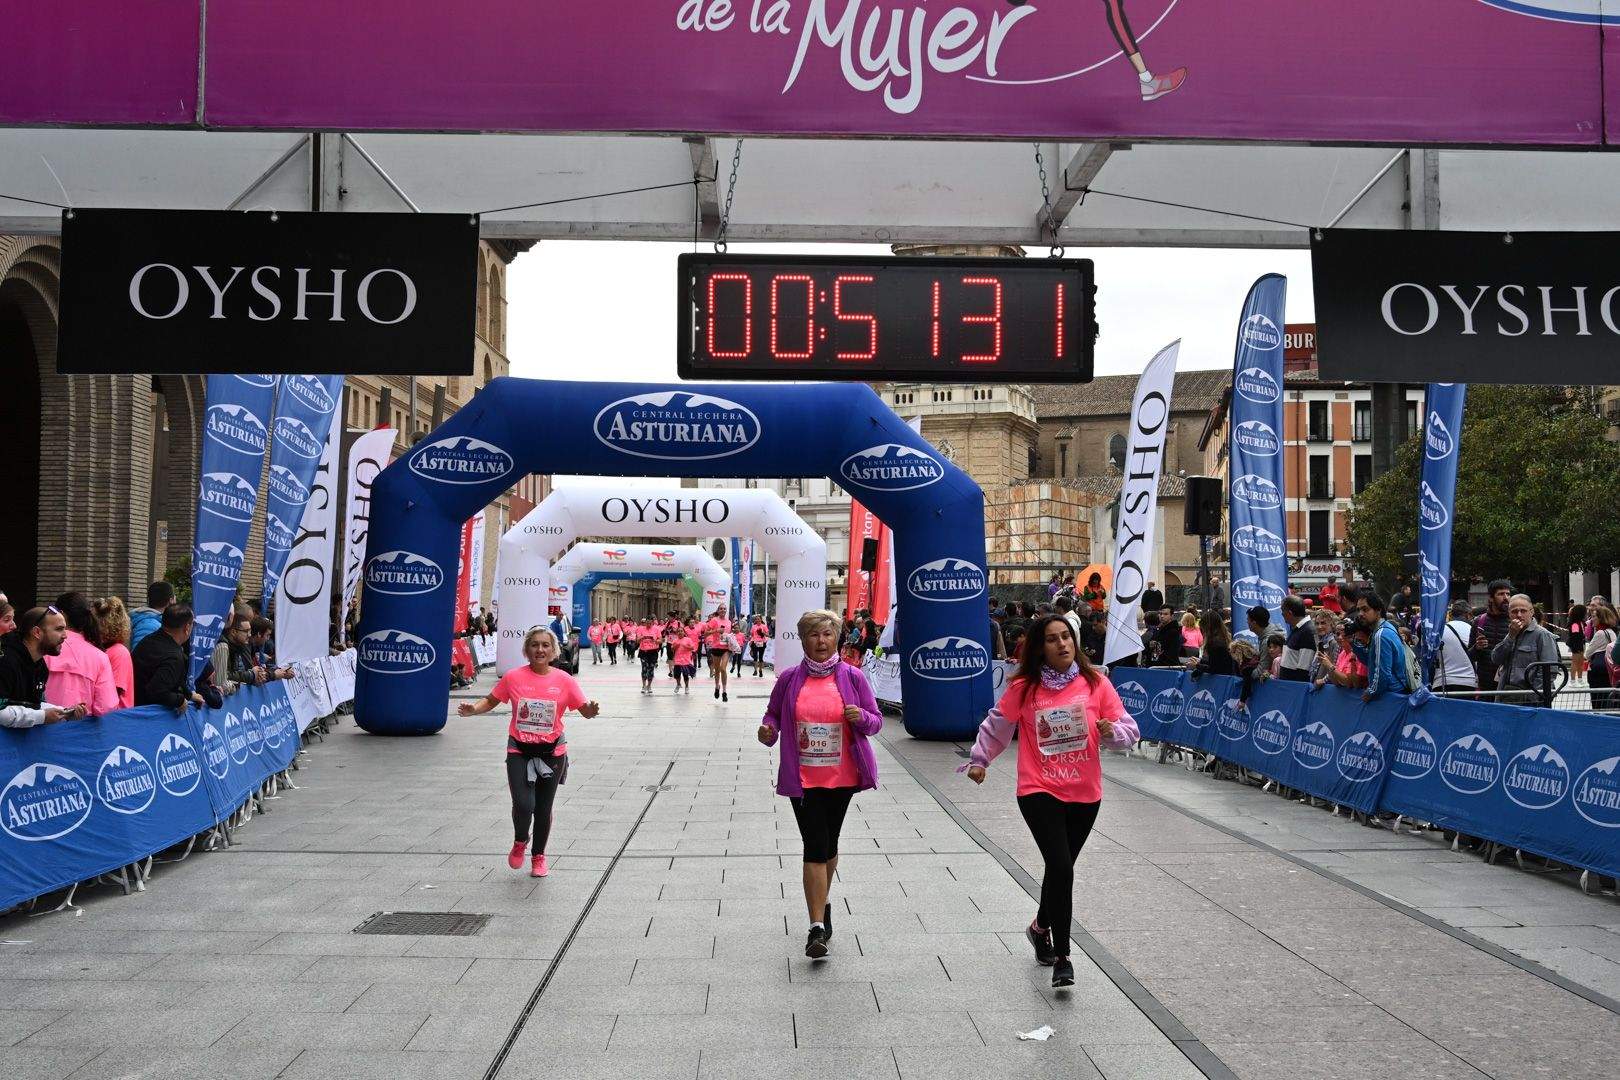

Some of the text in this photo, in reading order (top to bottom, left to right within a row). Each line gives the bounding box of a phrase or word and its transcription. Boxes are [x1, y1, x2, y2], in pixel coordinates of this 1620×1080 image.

[677, 0, 1038, 114] de la Mujer
[129, 263, 417, 325] OYSHO
[289, 376, 328, 410] ASTURIANA
[606, 411, 748, 443] ASTURIANA
[632, 410, 743, 420] CENTRAL LECHERA
[207, 412, 265, 450] ASTURIANA
[275, 422, 316, 455] ASTURIANA
[414, 452, 505, 473] ASTURIANA
[849, 462, 938, 479] ASTURIANA
[601, 498, 730, 524] OYSHO
[1115, 391, 1167, 605] OYSHO
[524, 525, 563, 535] OYSHO
[765, 526, 803, 536] OYSHO
[366, 565, 437, 585] ASTURIANA
[504, 577, 541, 587] OYSHO
[784, 579, 820, 589] OYSHO
[913, 575, 982, 592] ASTURIANA
[360, 644, 429, 663] ASTURIANA
[914, 653, 985, 670] ASTURIANA
[160, 758, 199, 785] ASTURIANA
[1395, 748, 1431, 769] TURIANA
[1442, 751, 1494, 783] ASTURIANA
[105, 773, 153, 802] ASTURIANA
[1506, 763, 1562, 797] ASTURIANA
[8, 791, 88, 829] ASTURIANA
